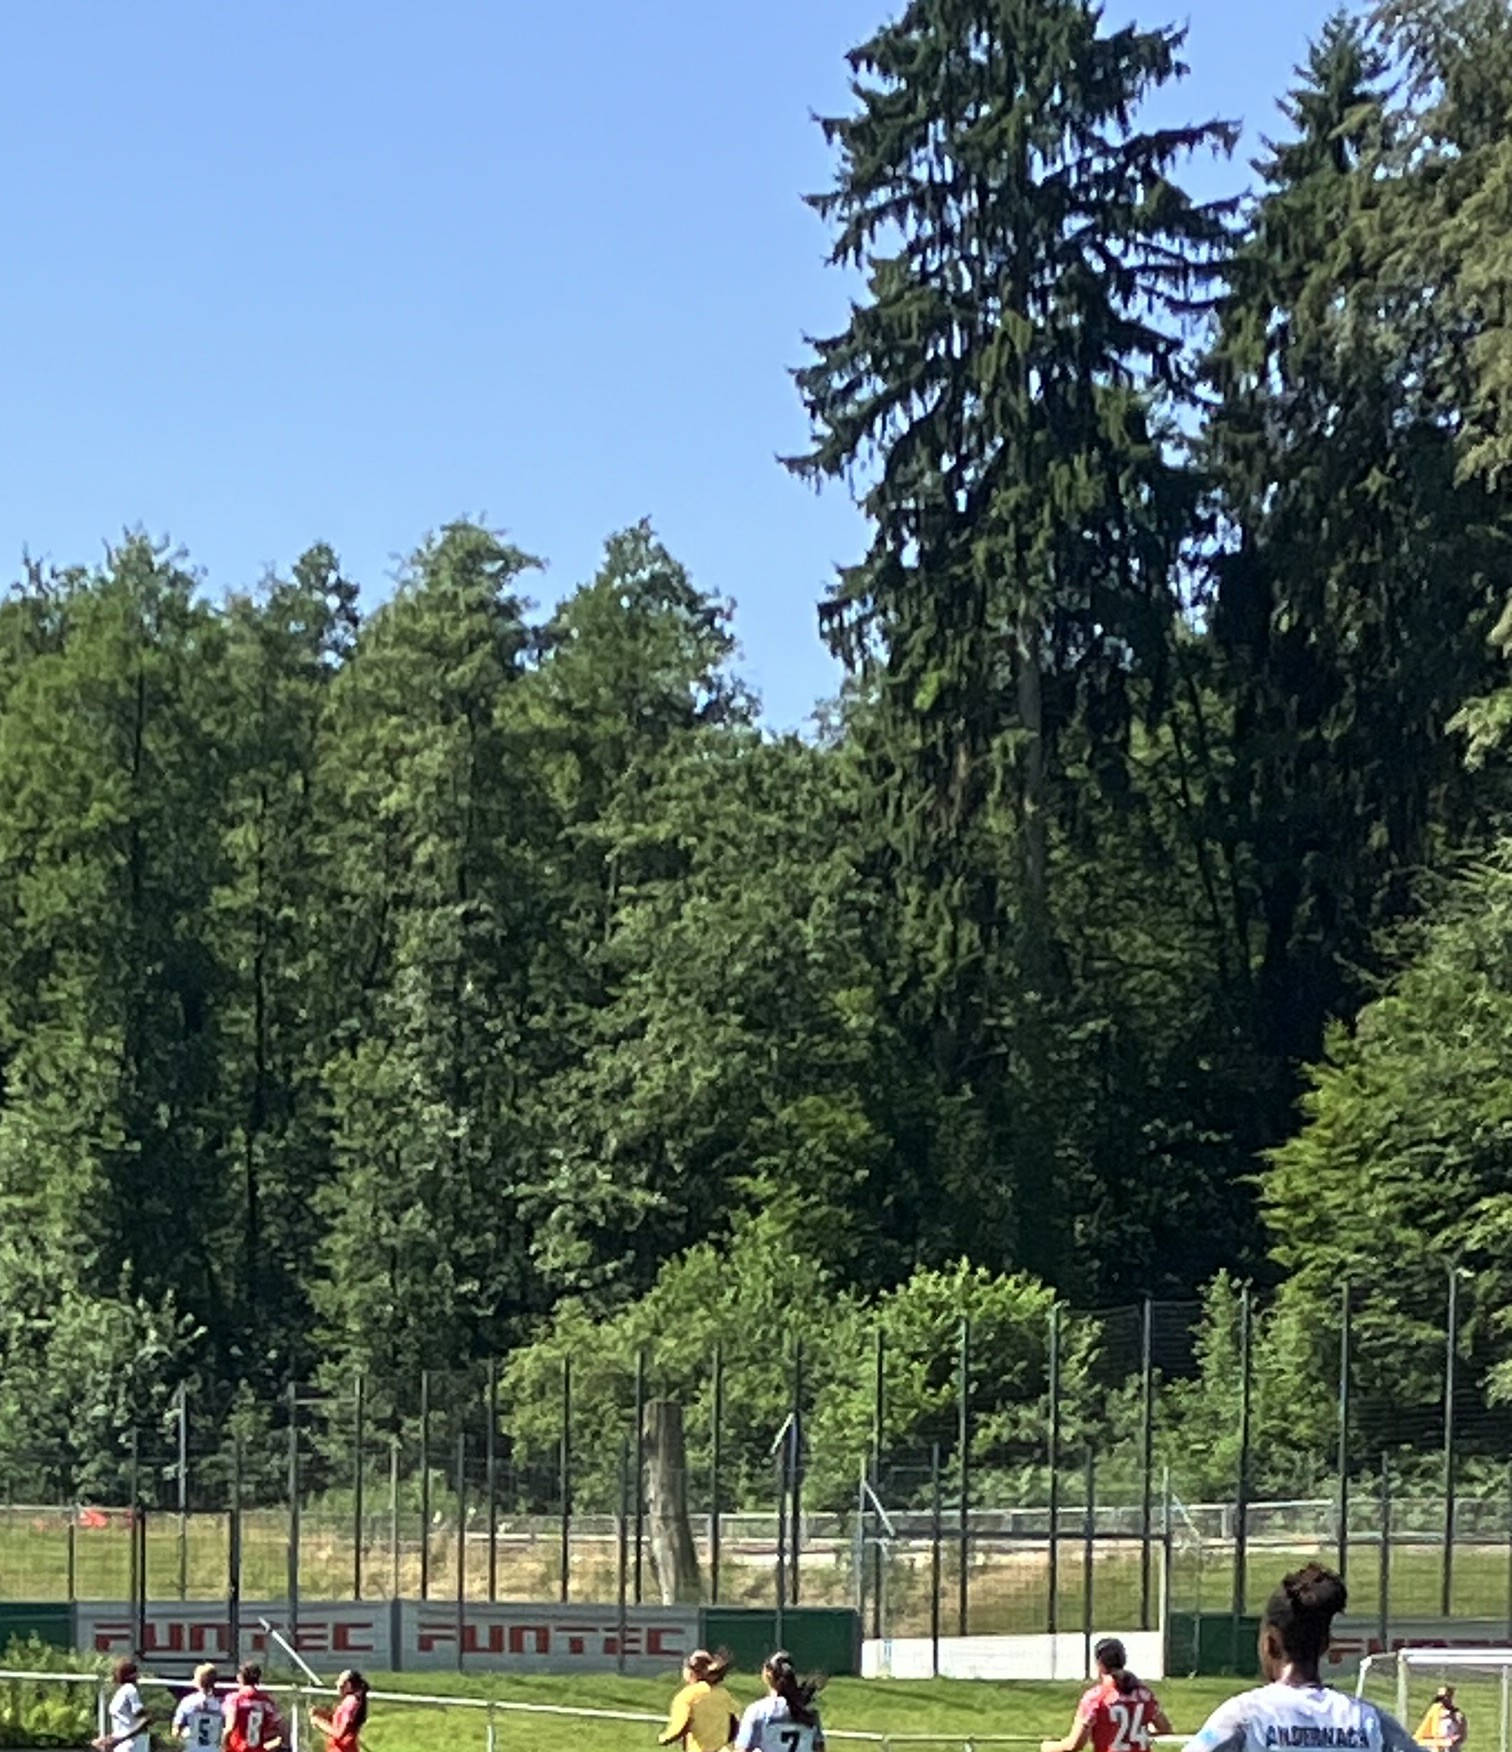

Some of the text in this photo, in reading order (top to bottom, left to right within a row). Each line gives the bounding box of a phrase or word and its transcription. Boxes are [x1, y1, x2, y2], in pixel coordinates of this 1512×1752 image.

[94, 1622, 373, 1652] FUNTEC
[417, 1624, 685, 1656] FUNTEC
[1109, 1703, 1150, 1752] 24
